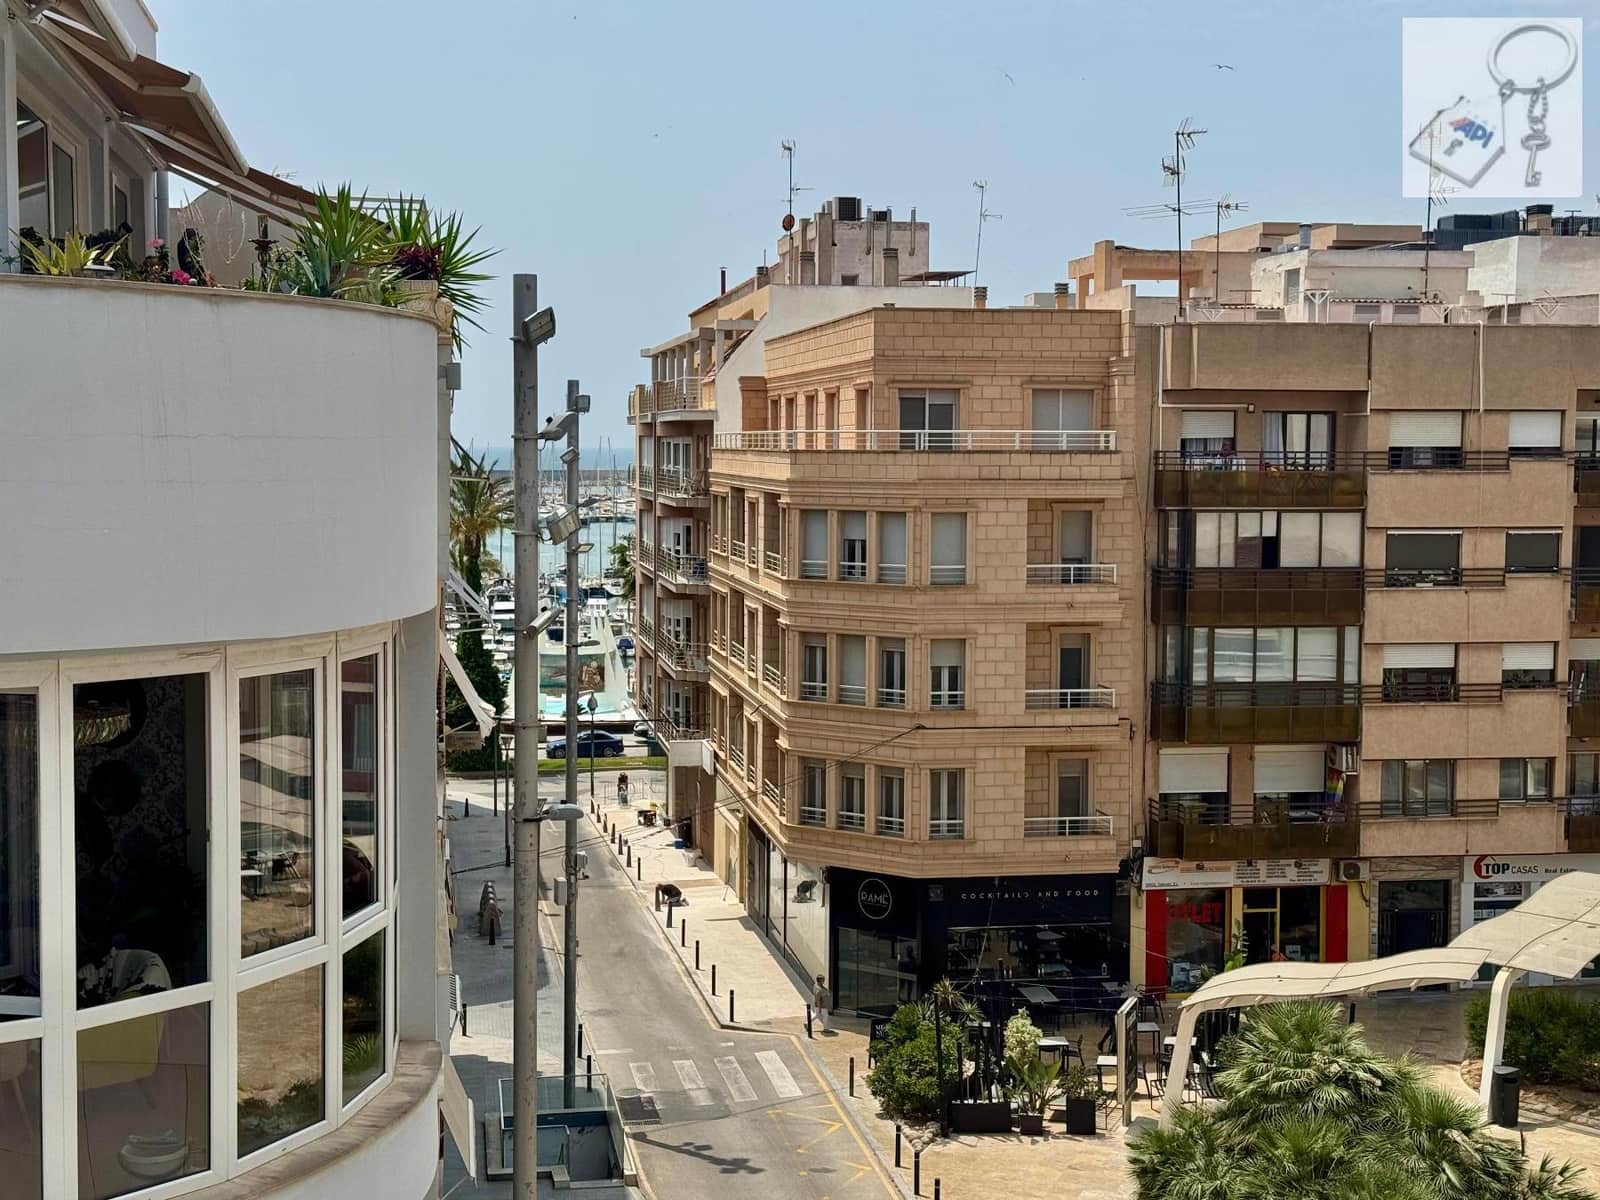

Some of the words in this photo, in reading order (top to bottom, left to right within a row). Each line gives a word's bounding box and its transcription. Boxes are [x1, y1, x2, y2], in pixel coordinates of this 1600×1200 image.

[1483, 863, 1510, 875] TOP
[1511, 865, 1539, 874] CASAS
[1038, 890, 1059, 898] AND
[1066, 889, 1100, 897] FOOD
